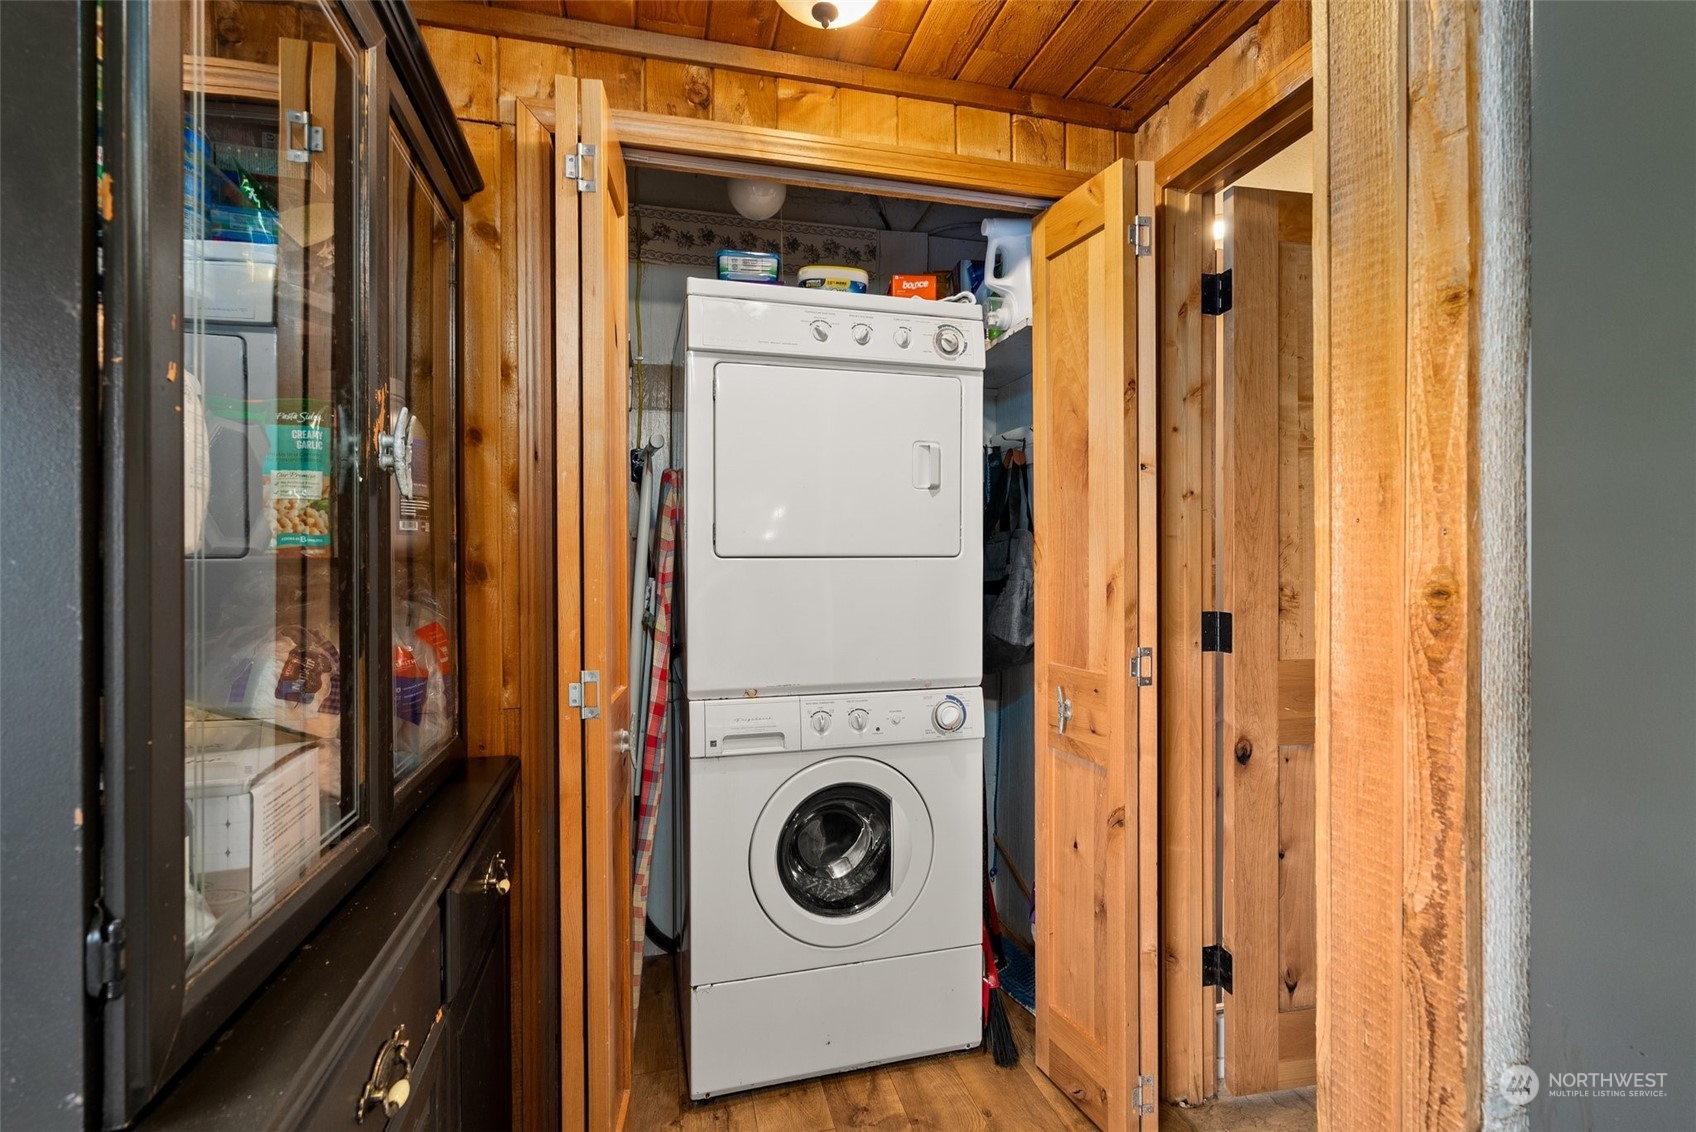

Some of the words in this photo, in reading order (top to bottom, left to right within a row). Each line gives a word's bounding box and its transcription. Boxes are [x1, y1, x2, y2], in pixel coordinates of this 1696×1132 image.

[903, 281, 929, 290] bounce
[291, 429, 324, 440] CREAMY
[296, 440, 324, 451] GARLIC
